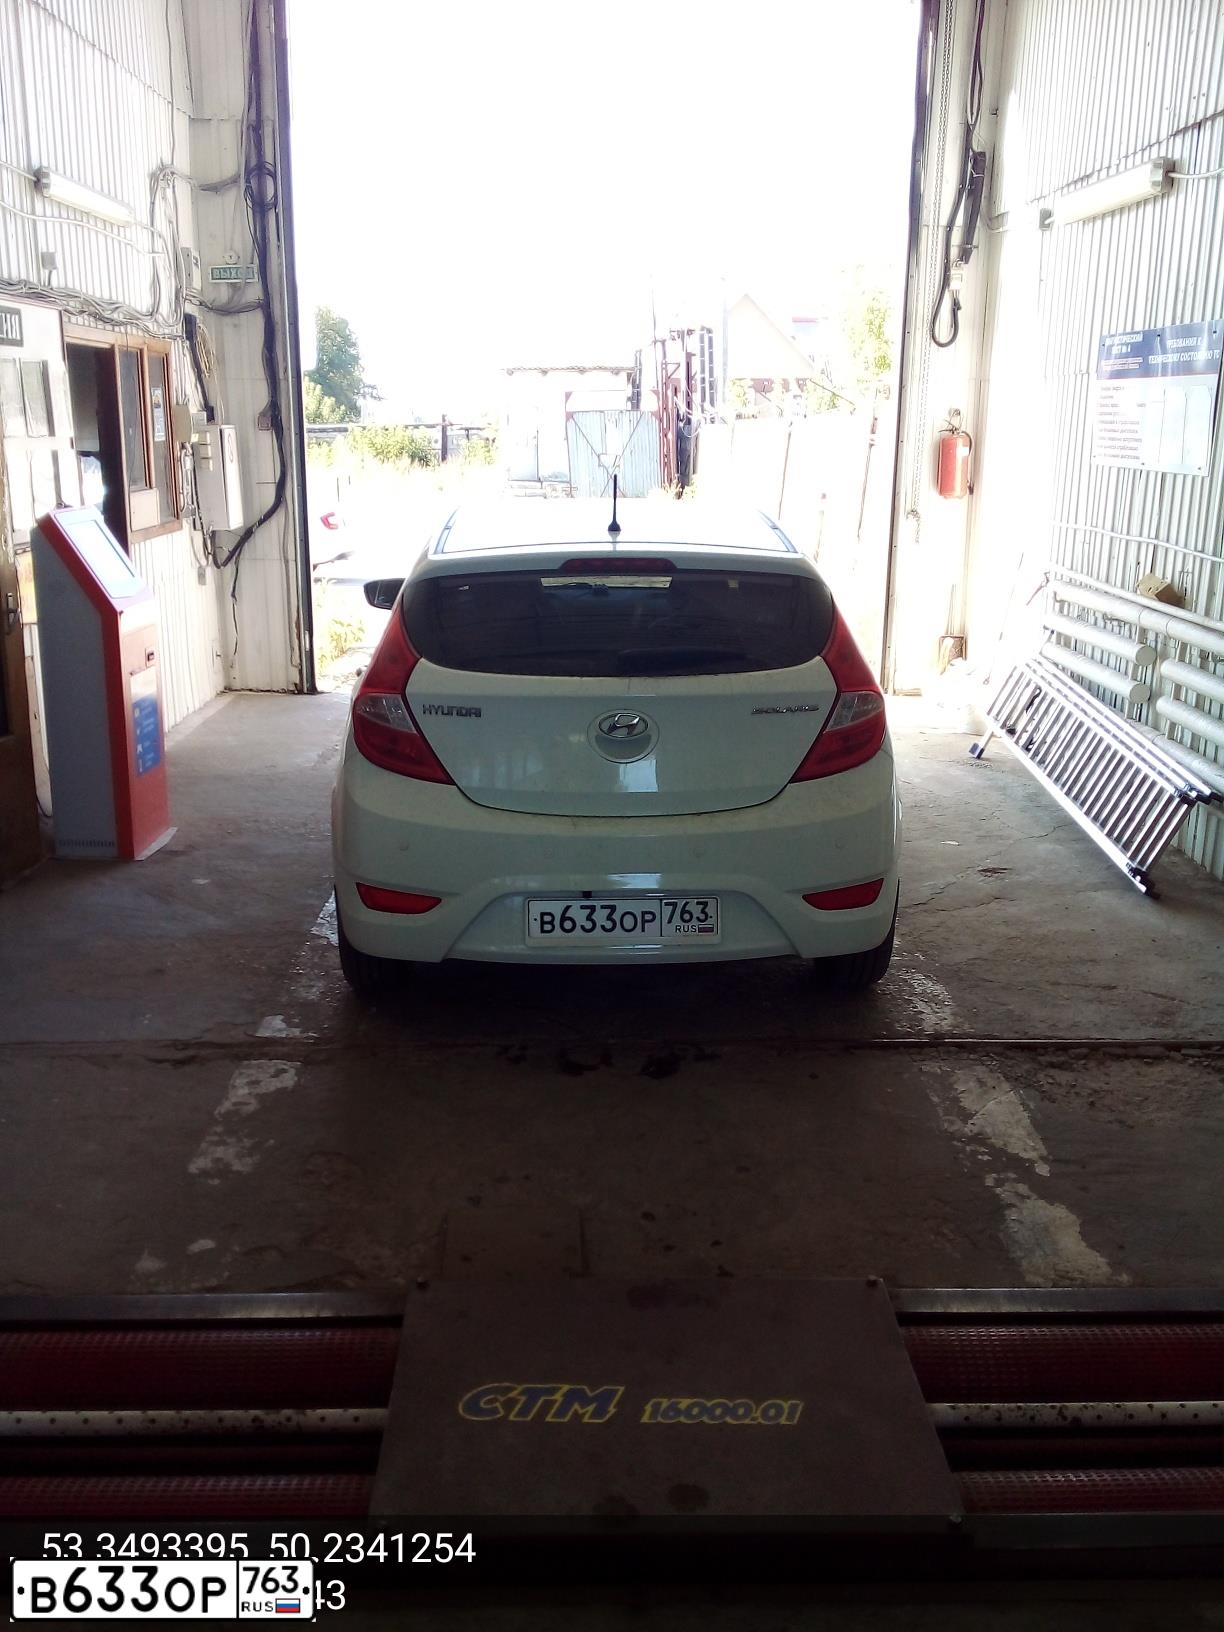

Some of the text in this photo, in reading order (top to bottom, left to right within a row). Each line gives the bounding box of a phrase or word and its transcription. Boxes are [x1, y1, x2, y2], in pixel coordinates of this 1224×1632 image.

[422, 704, 481, 718] HYUNDAI
[540, 901, 709, 934] В633ОР 763
[675, 924, 696, 933] RUS
[641, 1398, 804, 1424] 16000.01
